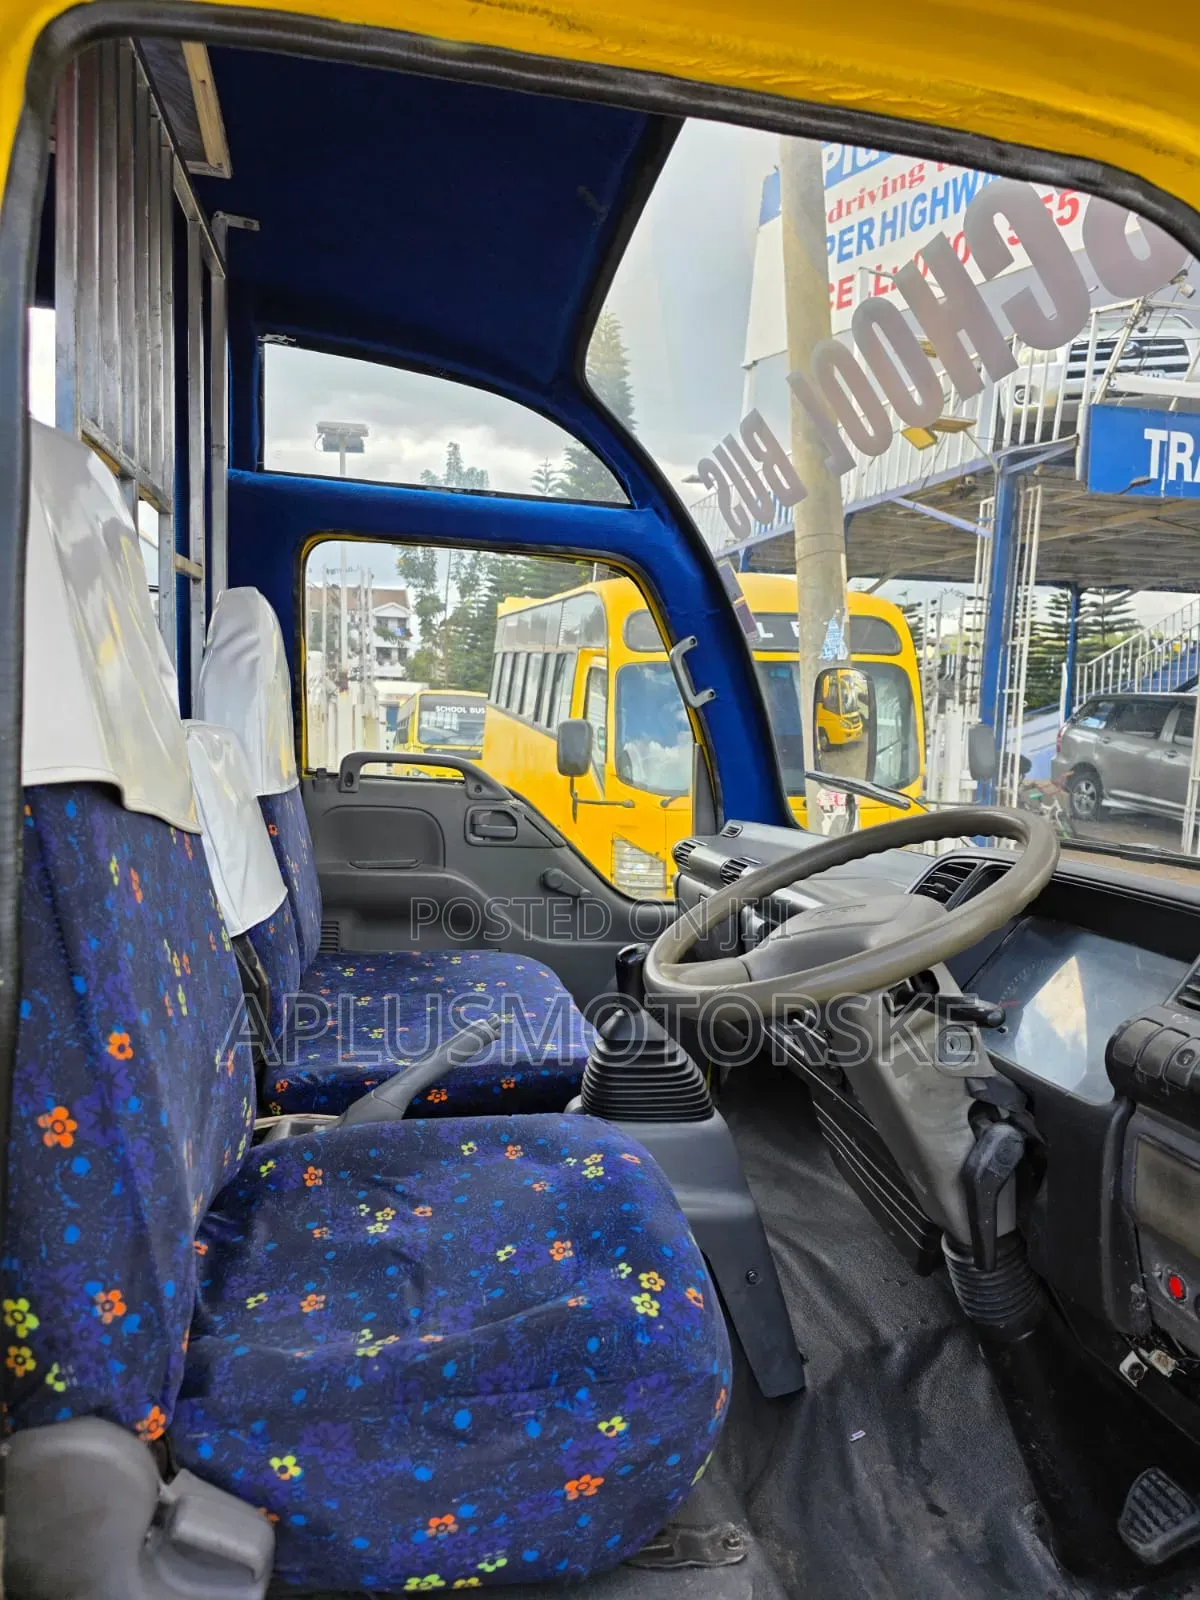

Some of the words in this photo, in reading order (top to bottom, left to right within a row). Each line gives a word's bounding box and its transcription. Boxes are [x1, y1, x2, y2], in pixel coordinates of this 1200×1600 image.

[827, 162, 925, 224] driving
[1144, 428, 1200, 483] TR
[435, 705, 467, 714] SCHOOL
